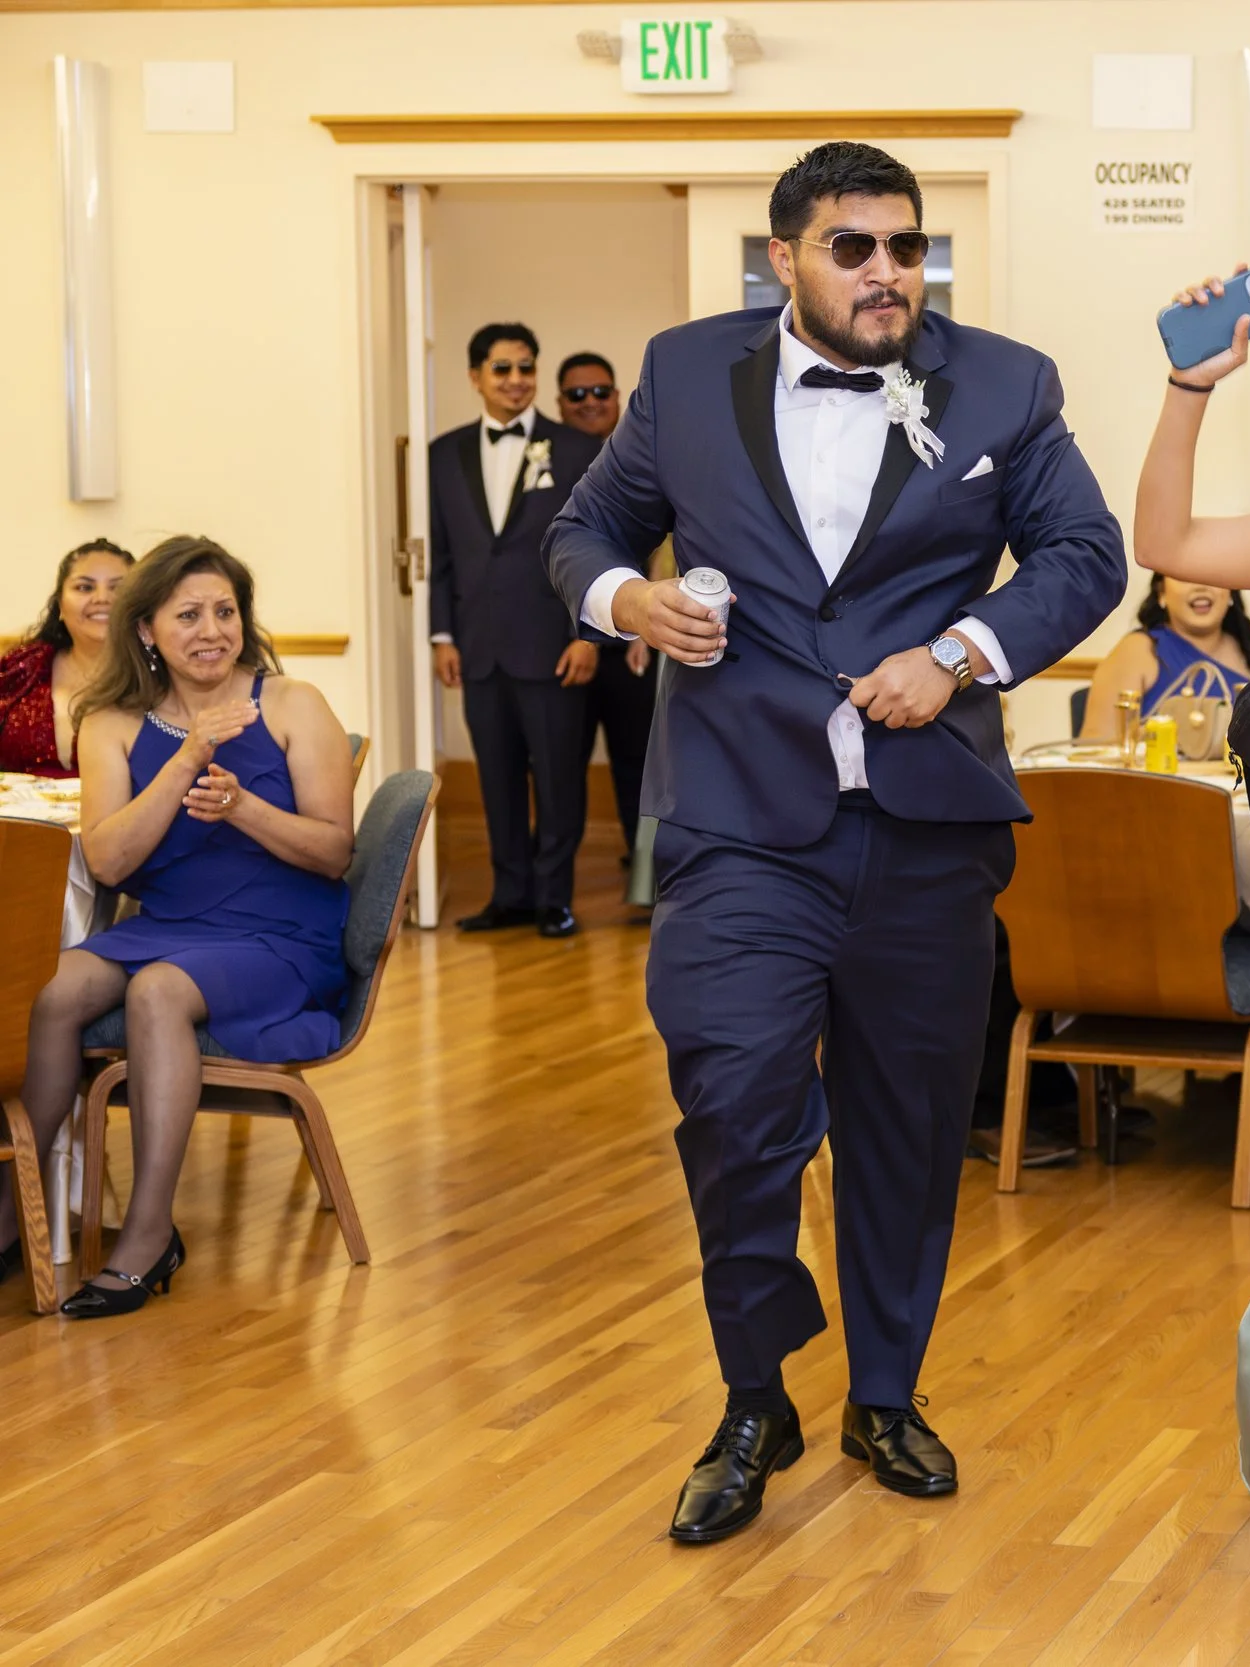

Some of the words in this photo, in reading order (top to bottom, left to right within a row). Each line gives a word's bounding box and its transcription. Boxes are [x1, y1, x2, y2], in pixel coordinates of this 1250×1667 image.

[640, 21, 713, 80] EXIT
[1095, 162, 1192, 184] OCCUPANCY
[1132, 198, 1185, 209] SEATED
[1132, 213, 1184, 224] DINING
